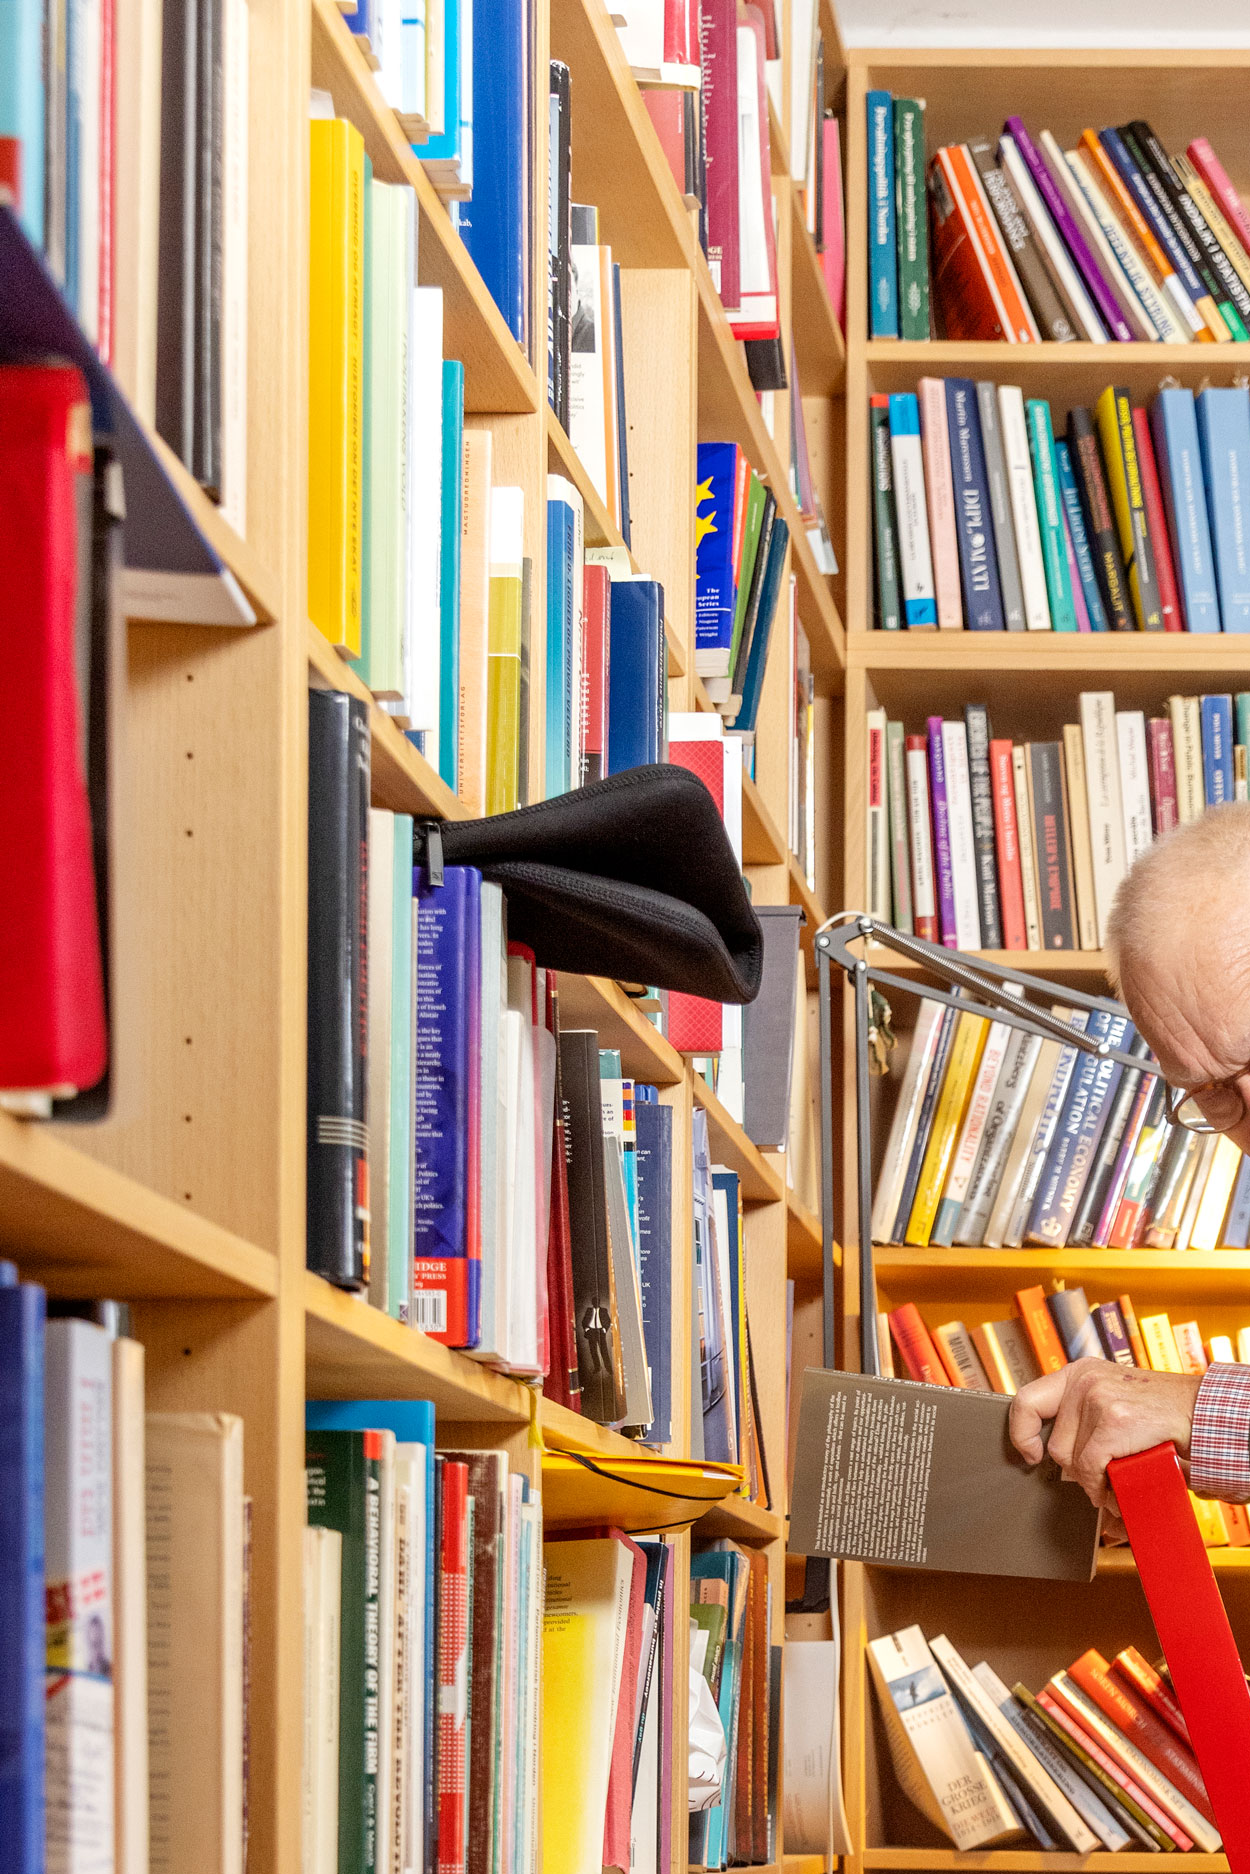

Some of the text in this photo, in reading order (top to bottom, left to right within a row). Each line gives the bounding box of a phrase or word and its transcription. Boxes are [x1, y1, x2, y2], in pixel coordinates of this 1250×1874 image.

[1177, 191, 1217, 247] INDBLIK
[1206, 242, 1221, 255] I
[954, 390, 973, 482] Martin Marcussen
[1102, 551, 1123, 611] MARGALIT
[966, 711, 993, 838] ENEMIES OF THE PEOPLE
[980, 854, 997, 925] Kati Marton
[1043, 815, 1061, 910] HITLER'S EMPIRE
[1105, 1015, 1127, 1048] THE
[959, 1048, 1001, 1163] BEYOND RATIONALITY
[968, 1100, 1007, 1202] of Organizations
[1056, 1133, 1093, 1214] ECONOMY
[872, 1375, 902, 1384] NUTS
[924, 1382, 961, 1393] BOLTS
[947, 1335, 974, 1373] MOUNK
[366, 1492, 378, 1598] BEHAVIORAL
[395, 1537, 405, 1600] DAHL
[365, 1601, 377, 1665] THEORY
[615, 1577, 625, 1629] Economics
[653, 1590, 662, 1619] praise
[394, 1612, 404, 1683] AFTER
[642, 1637, 656, 1698] bureaucracy
[365, 1690, 377, 1728] THE
[394, 1703, 403, 1748] THE
[365, 1731, 376, 1774] FIRM
[946, 1774, 973, 1790] DER
[365, 1782, 374, 1815] Cyert
[941, 1781, 985, 1803] GROSSE
[950, 1794, 987, 1814] KRIEG
[364, 1829, 374, 1867] March
